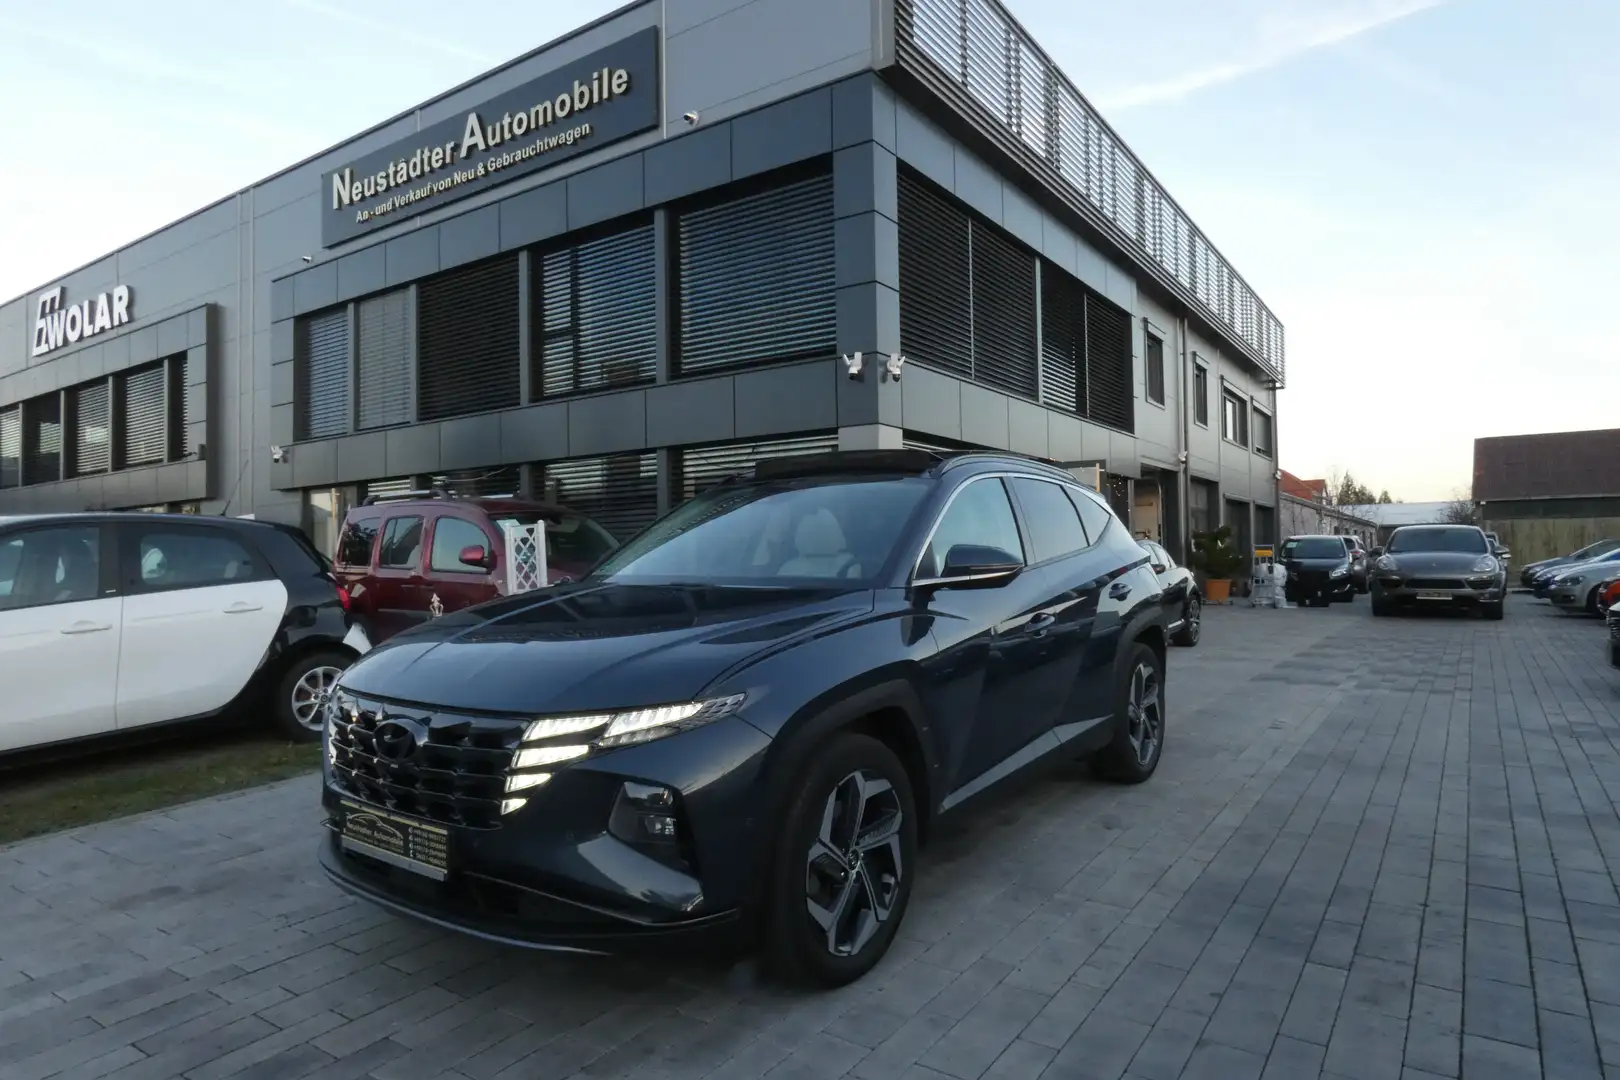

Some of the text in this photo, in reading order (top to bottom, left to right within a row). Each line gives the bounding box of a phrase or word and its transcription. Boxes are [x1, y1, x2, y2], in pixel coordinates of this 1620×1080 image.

[332, 67, 628, 210] Neustädter Automobile
[375, 198, 393, 215] und
[394, 182, 432, 208] Verkauf
[432, 177, 452, 192] von
[453, 168, 475, 185] Neu
[476, 162, 486, 176] &
[487, 122, 590, 172] Gebrauchtwagen
